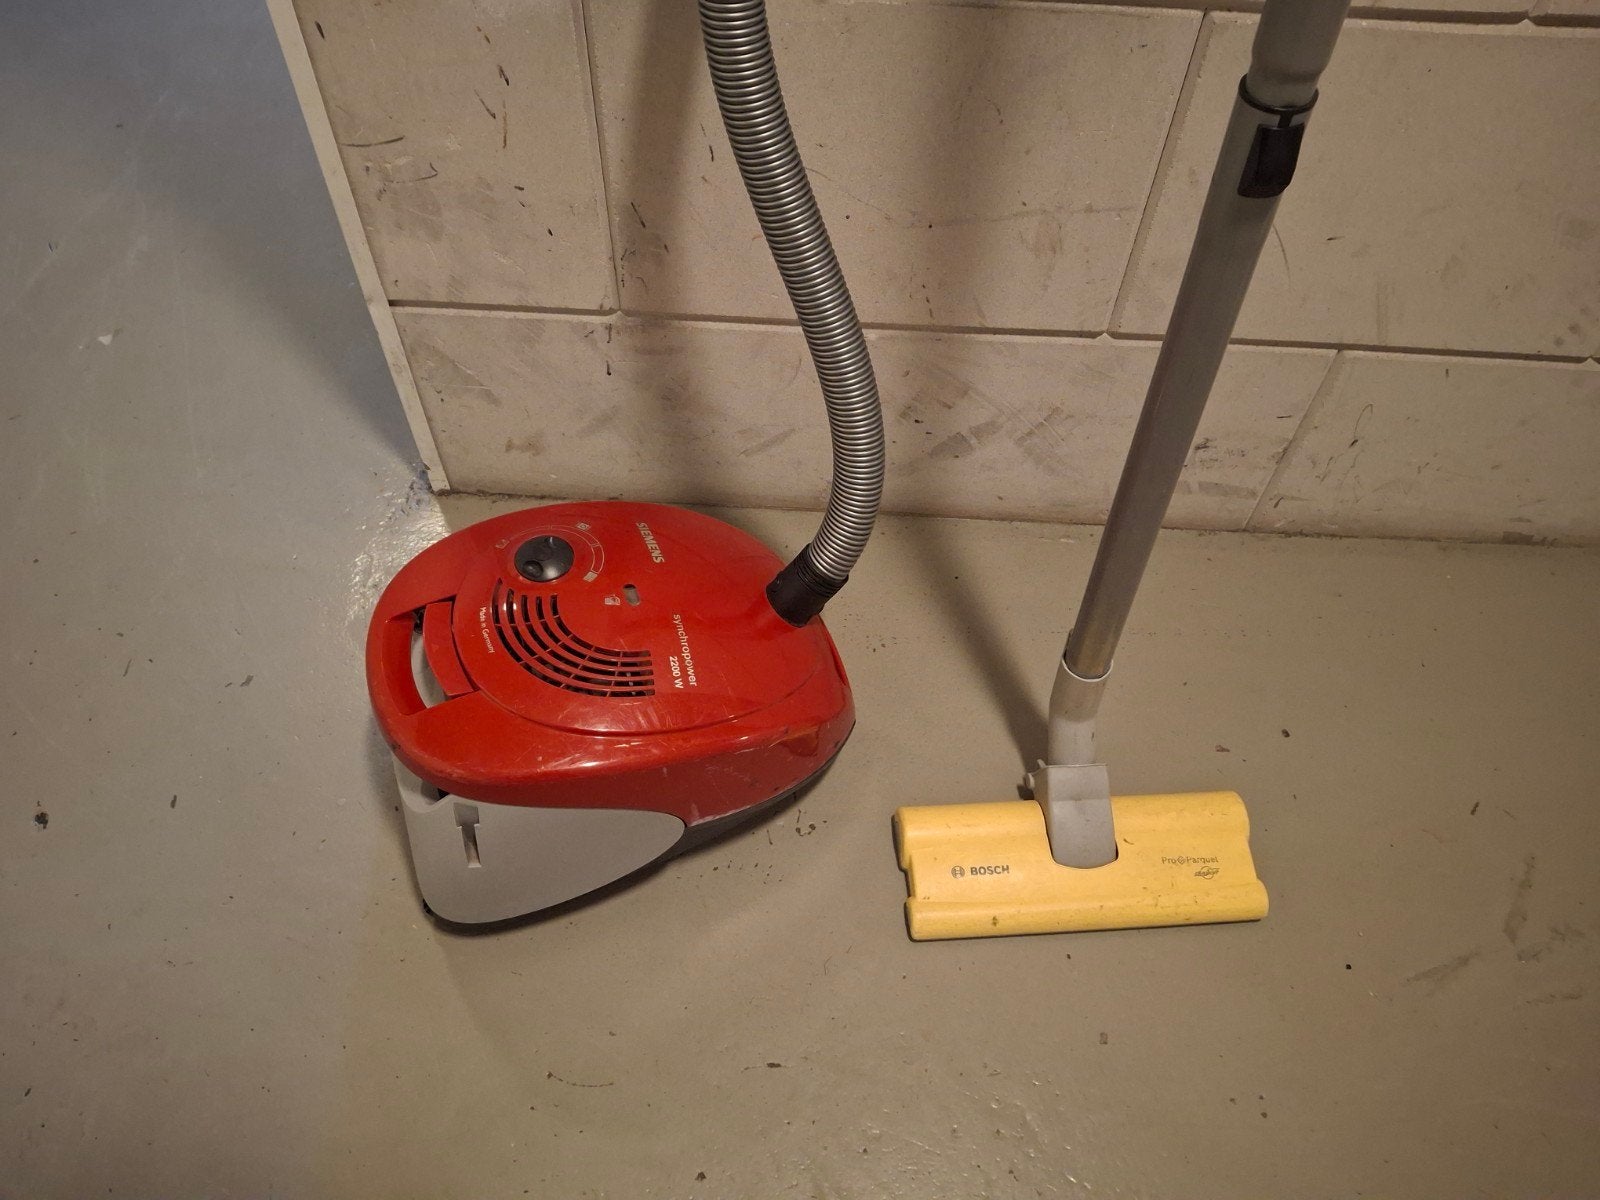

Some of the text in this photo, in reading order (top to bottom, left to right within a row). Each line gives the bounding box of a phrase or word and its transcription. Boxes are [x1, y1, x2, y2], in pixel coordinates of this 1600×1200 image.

[636, 522, 665, 564] SIEMENS
[673, 614, 698, 687] synchropower
[669, 656, 684, 689] 2200 W
[970, 864, 1010, 876] BOSCH
